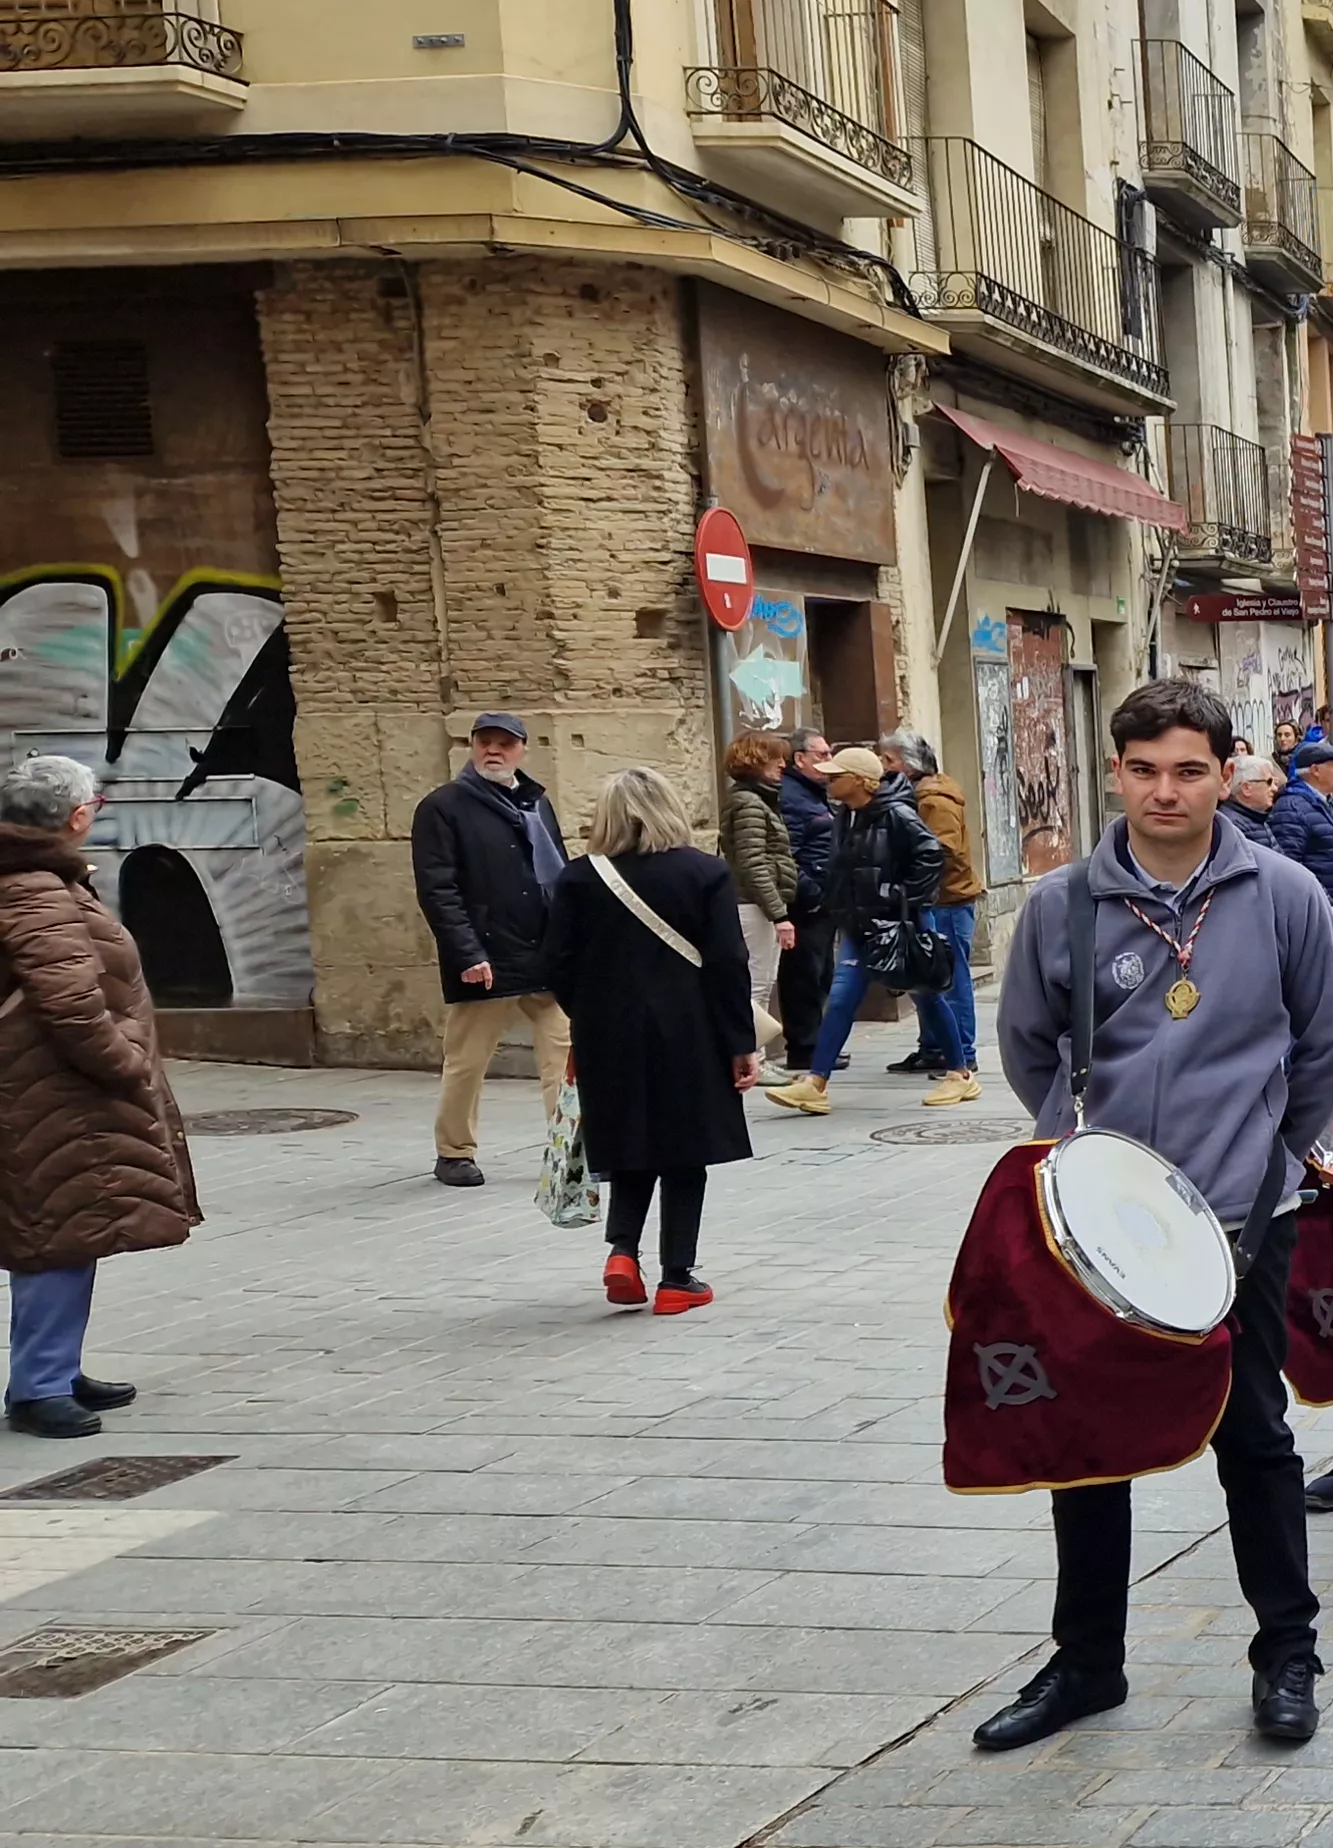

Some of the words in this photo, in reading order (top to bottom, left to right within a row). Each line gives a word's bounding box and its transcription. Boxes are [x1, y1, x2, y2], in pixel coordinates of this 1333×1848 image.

[1236, 598, 1261, 608] Iglesia
[1267, 598, 1299, 607] Claustro
[1221, 607, 1232, 617] de
[1233, 606, 1249, 616] San
[1249, 606, 1272, 616] Pedro
[1273, 606, 1281, 616] el
[1281, 606, 1299, 617] Viejo
[1096, 1246, 1126, 1279] EVANS
